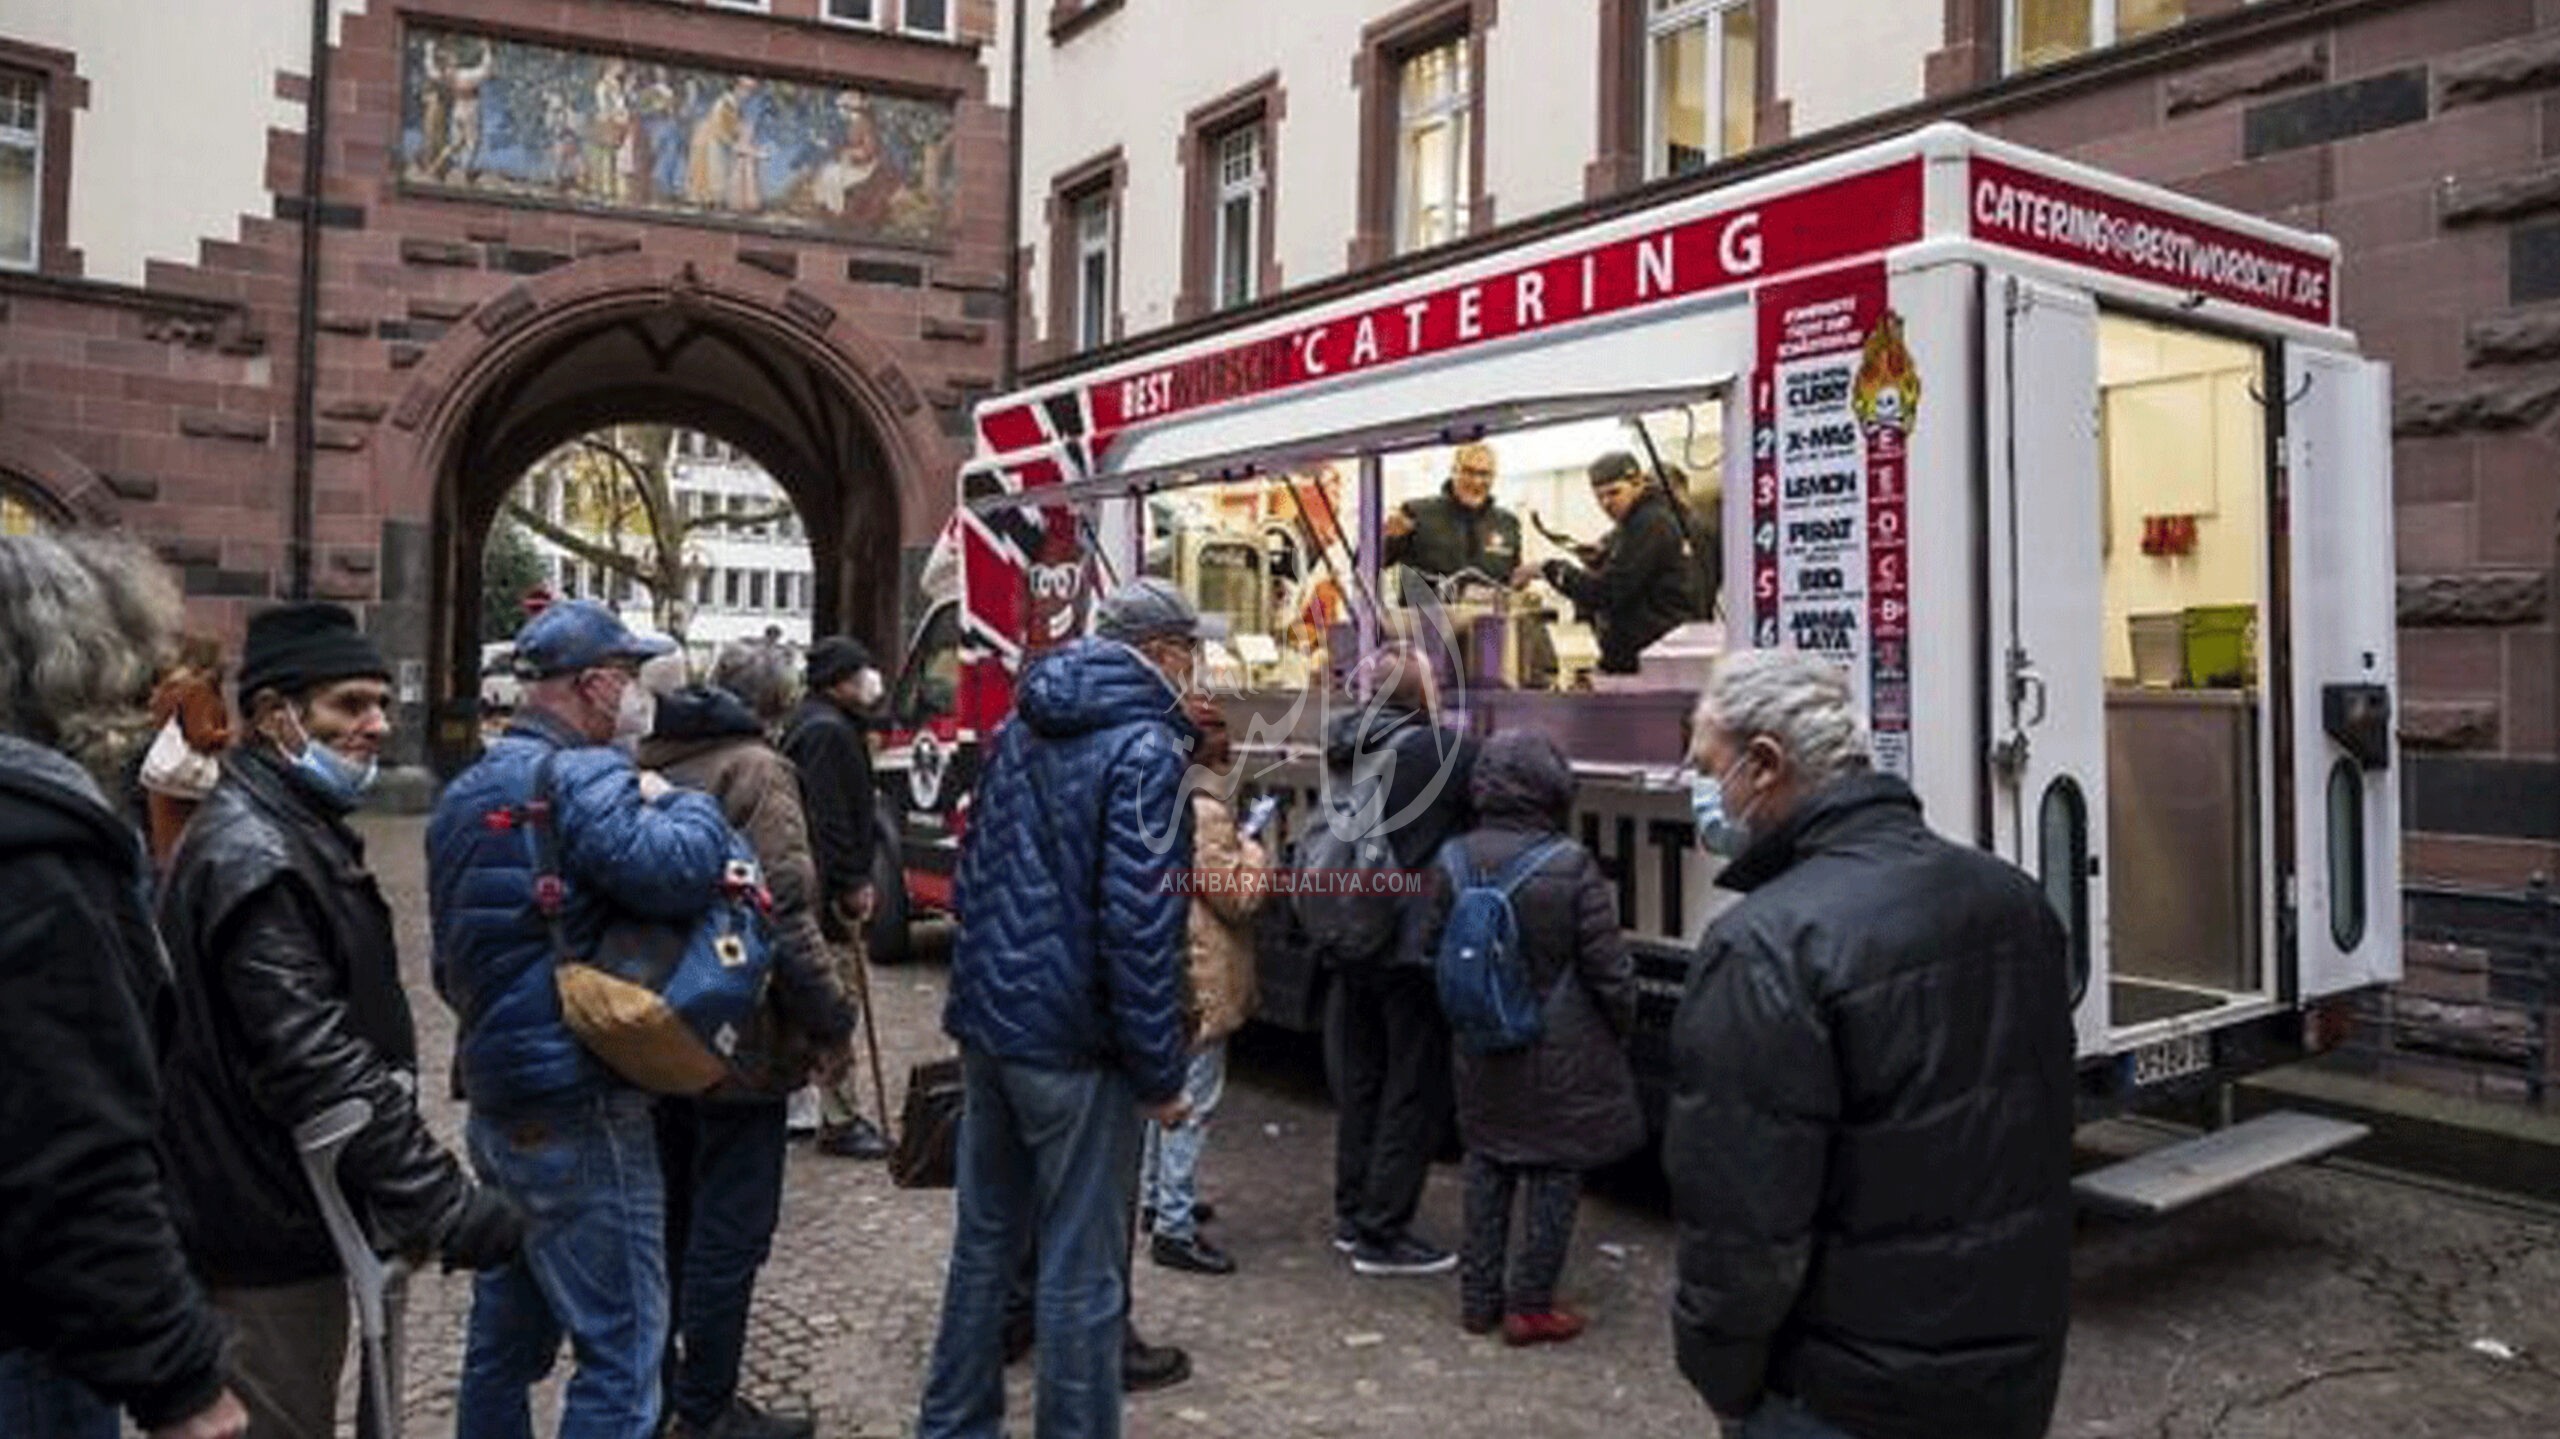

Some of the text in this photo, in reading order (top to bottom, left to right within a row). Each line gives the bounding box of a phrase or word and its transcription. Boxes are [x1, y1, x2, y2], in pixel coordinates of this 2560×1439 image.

[1303, 211, 1763, 375] CATERING
[1756, 428, 1774, 459] 2
[1785, 422, 1856, 453] X-MAS
[1757, 470, 1857, 505] 3 LEMON
[1755, 521, 1775, 552] 4
[1756, 568, 1775, 598] 5
